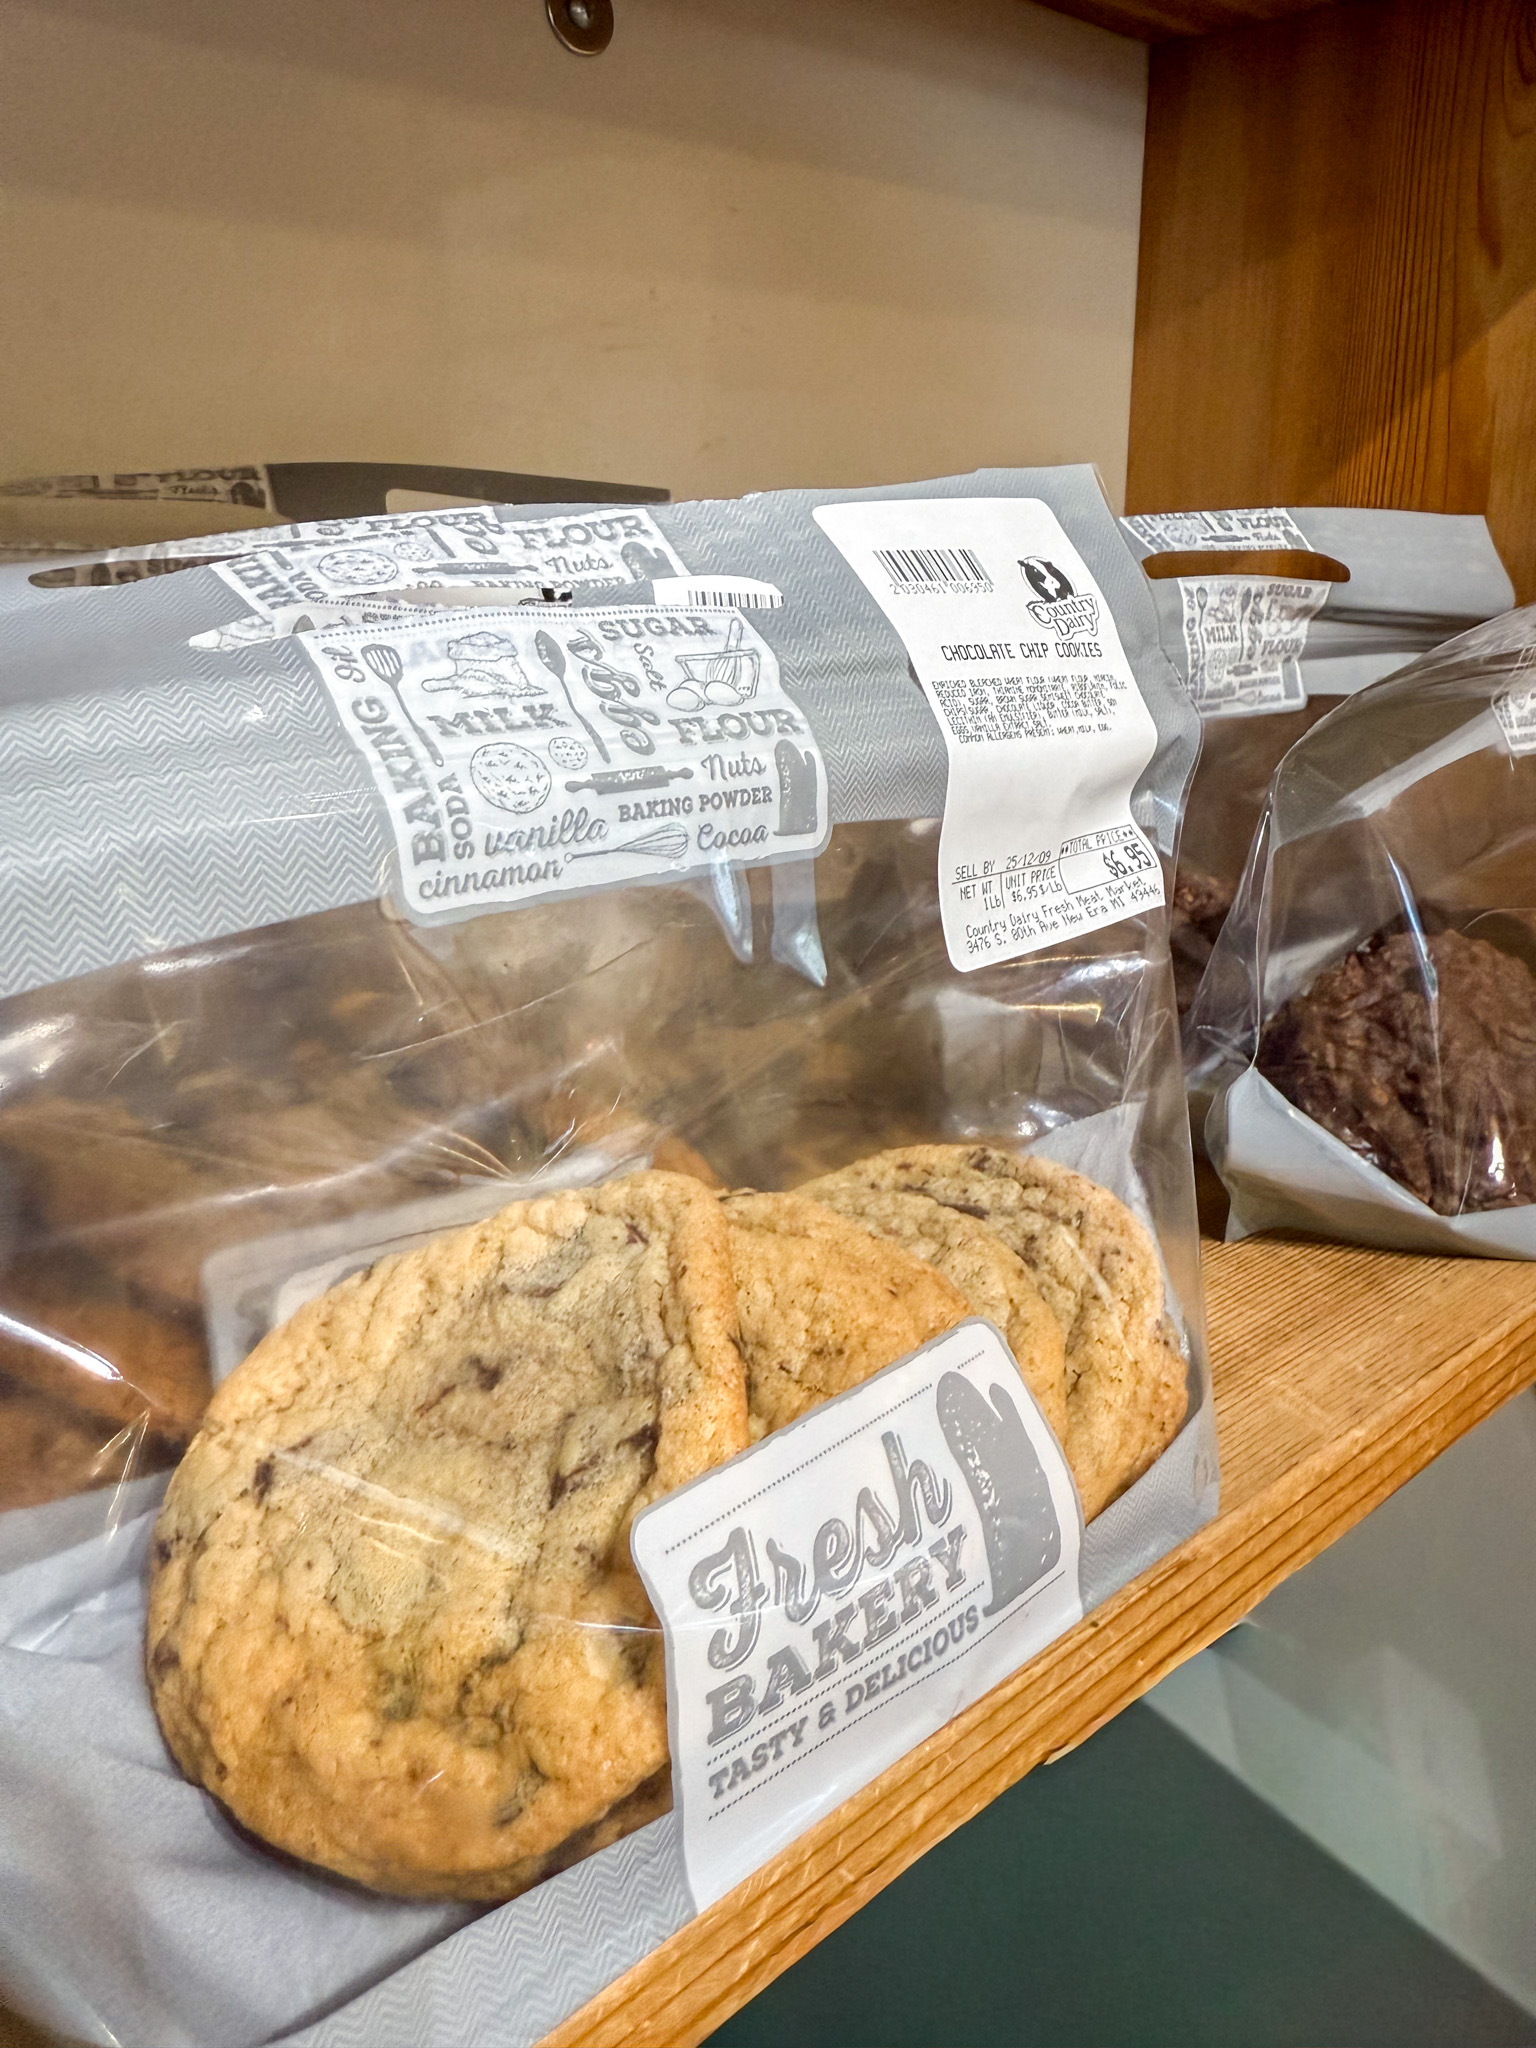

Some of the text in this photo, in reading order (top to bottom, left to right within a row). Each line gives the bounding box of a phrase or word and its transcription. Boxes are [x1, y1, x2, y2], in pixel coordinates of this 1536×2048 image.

[513, 514, 653, 549] FLOUR
[544, 553, 614, 574] Nuts
[1031, 597, 1096, 624] Country
[1053, 614, 1094, 636] Dairy
[598, 616, 721, 641] SUGAR
[1204, 624, 1239, 644] MILK
[941, 642, 1103, 661] CHOCOLATE CHIP COOKIES
[426, 703, 572, 738] MILK
[667, 707, 805, 744] FLOUR
[351, 695, 447, 866] BAKING
[700, 751, 767, 782] Nuts
[437, 772, 476, 860] SODA
[617, 786, 774, 823] BAKING POWDER
[484, 805, 609, 857] vanilla
[696, 822, 769, 850] Cocoa
[955, 850, 1052, 881] SELL BY 25/12/09
[1005, 865, 1057, 890] UNIT PRICE
[1102, 842, 1152, 878] $6.95
[418, 858, 564, 899] cinnamon
[960, 880, 993, 901] NET WT
[965, 919, 1008, 939] Country
[1008, 911, 1040, 927] Dairy
[1041, 898, 1075, 918] Fresh
[1075, 889, 1104, 907] Meat
[966, 935, 992, 953] 3476
[994, 932, 1007, 946] S.
[1010, 924, 1037, 941] 80th
[1038, 919, 1060, 933] Ave
[1060, 913, 1084, 926] New
[1085, 904, 1109, 918] Era
[1109, 895, 1126, 909] MI
[688, 1430, 952, 1672] Fresh
[706, 1523, 968, 1747] BAKERY
[708, 1604, 980, 1800] TASTY & DELICIOUS
